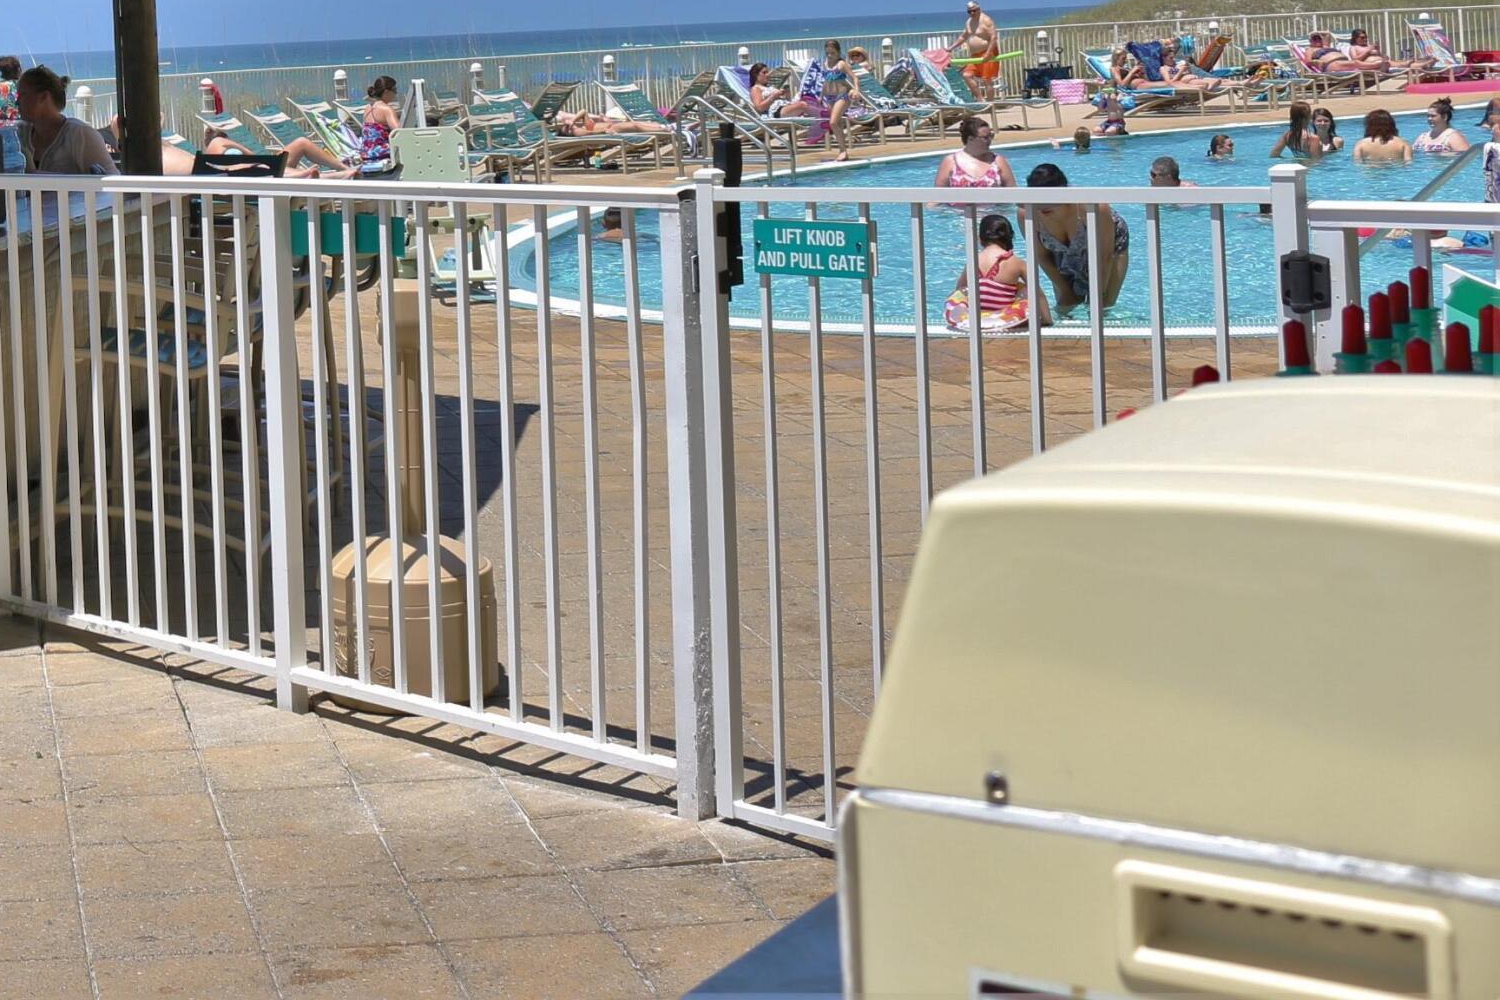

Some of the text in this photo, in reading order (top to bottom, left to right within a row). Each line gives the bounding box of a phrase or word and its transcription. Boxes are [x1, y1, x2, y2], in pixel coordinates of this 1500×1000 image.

[774, 227, 845, 247] LIFT KNOB
[757, 250, 866, 272] AND PULL GATE
